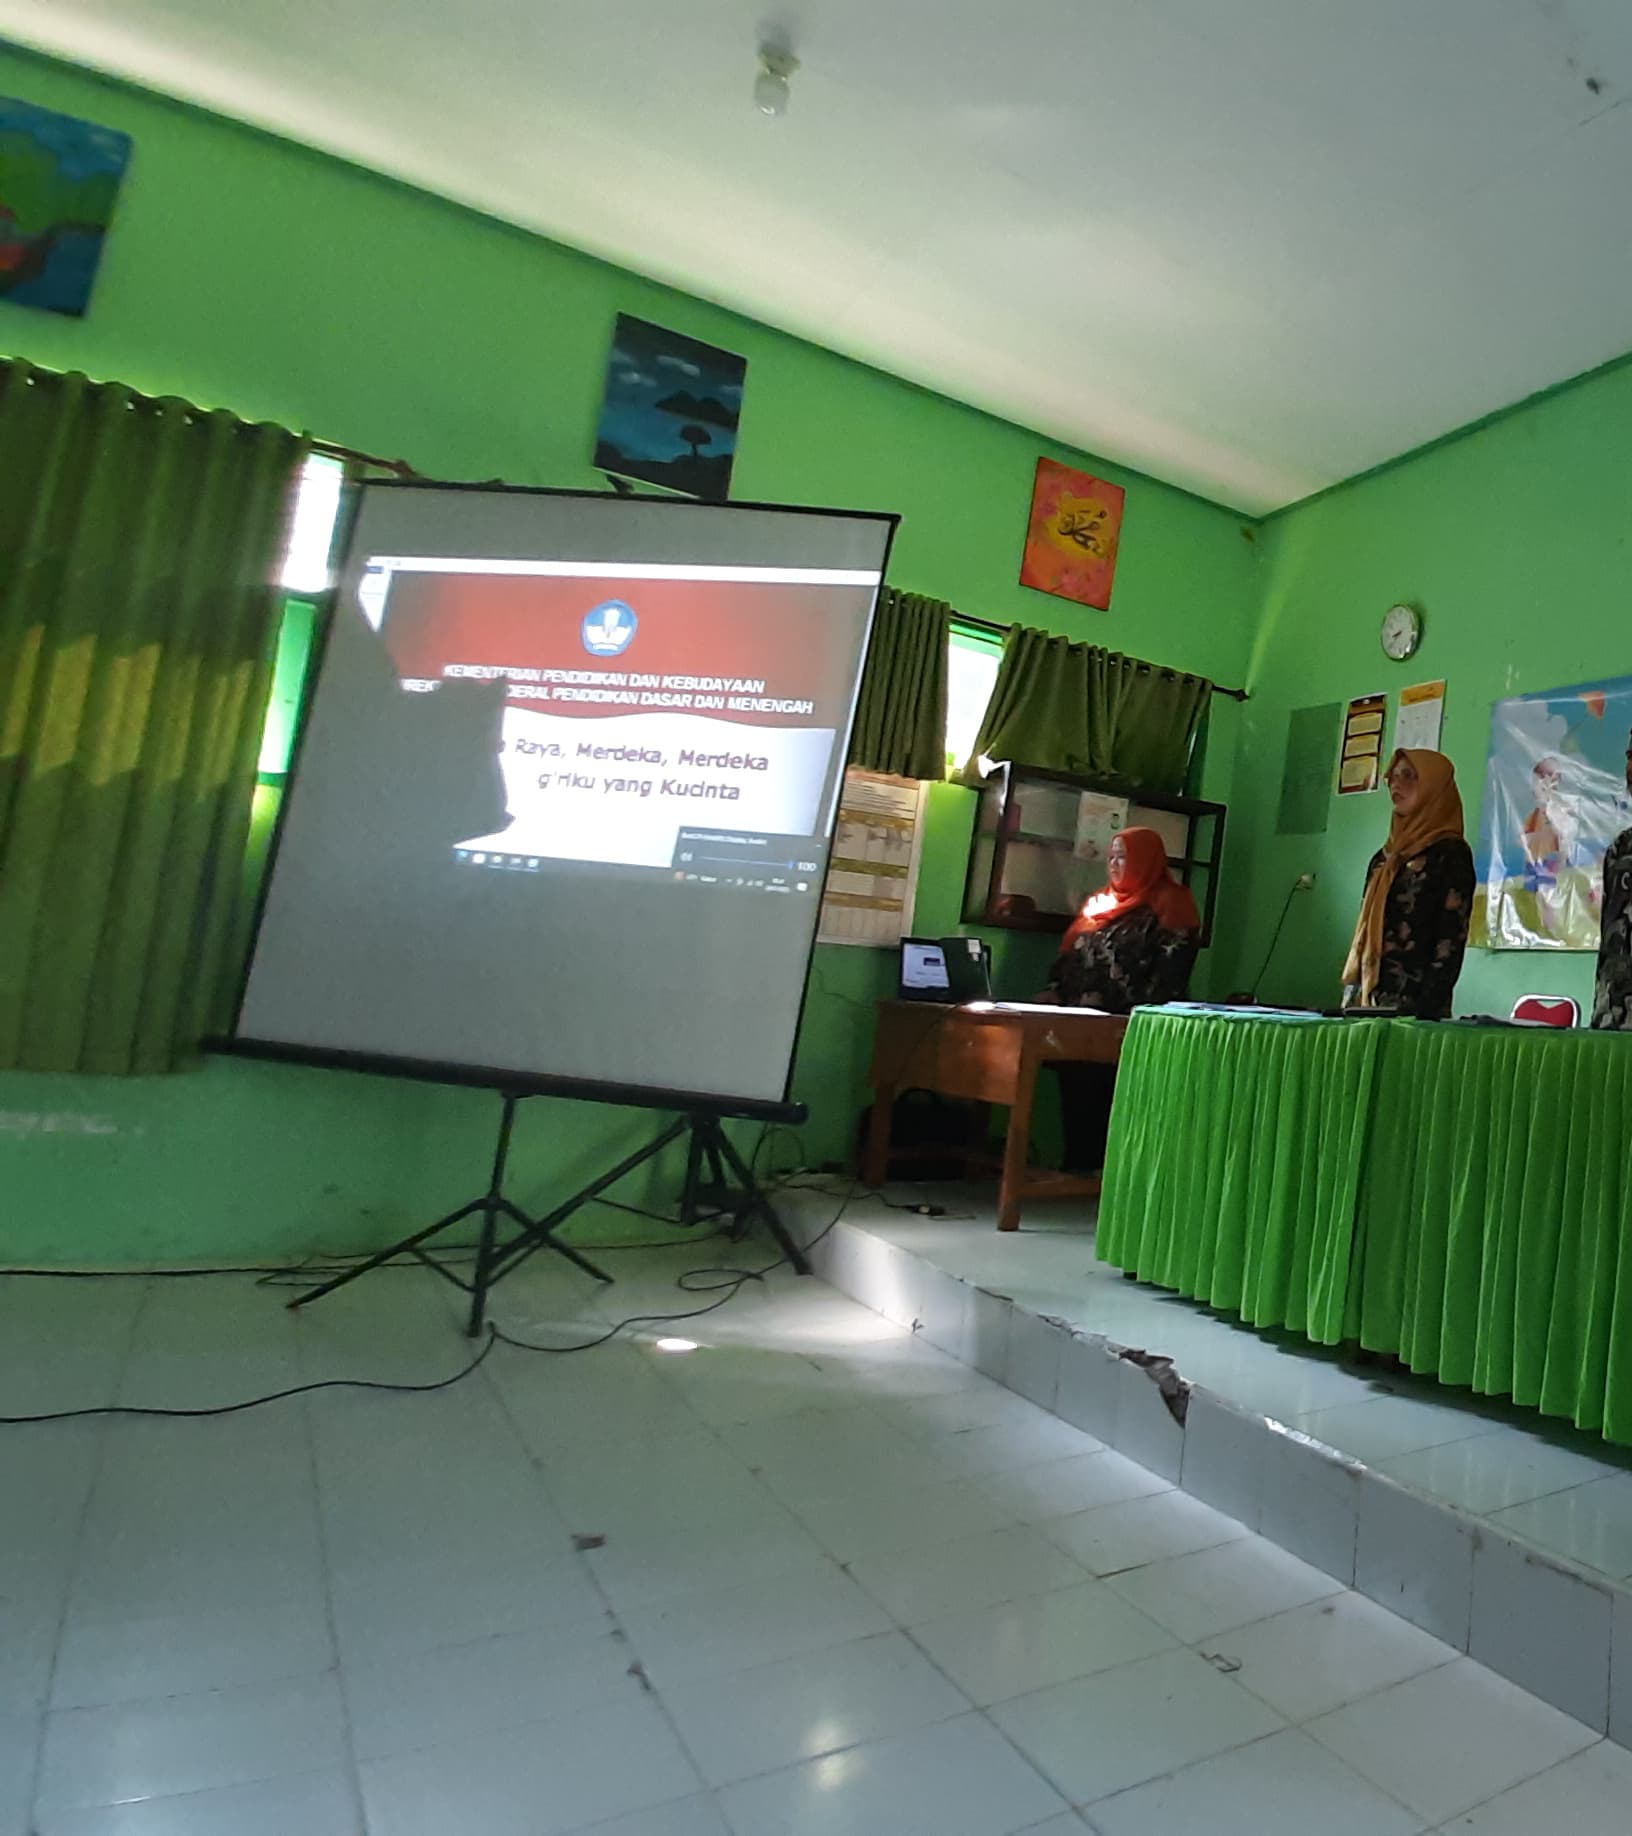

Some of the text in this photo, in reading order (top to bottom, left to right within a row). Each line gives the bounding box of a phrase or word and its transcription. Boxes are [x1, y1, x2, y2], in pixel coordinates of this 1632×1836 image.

[444, 664, 765, 693] KEMENTERIAN PENDIDIKAN DAN KEBUDAYAAN
[552, 687, 639, 706] PENDIDIKAN
[641, 692, 692, 708] DASAR
[694, 695, 725, 711] DAN
[727, 697, 814, 715] MENENGAH
[515, 738, 566, 759] Raya,
[576, 742, 667, 767] Merdeka,
[678, 749, 769, 771] Merdeka
[604, 777, 652, 797] yang
[660, 778, 741, 800] Kucinta
